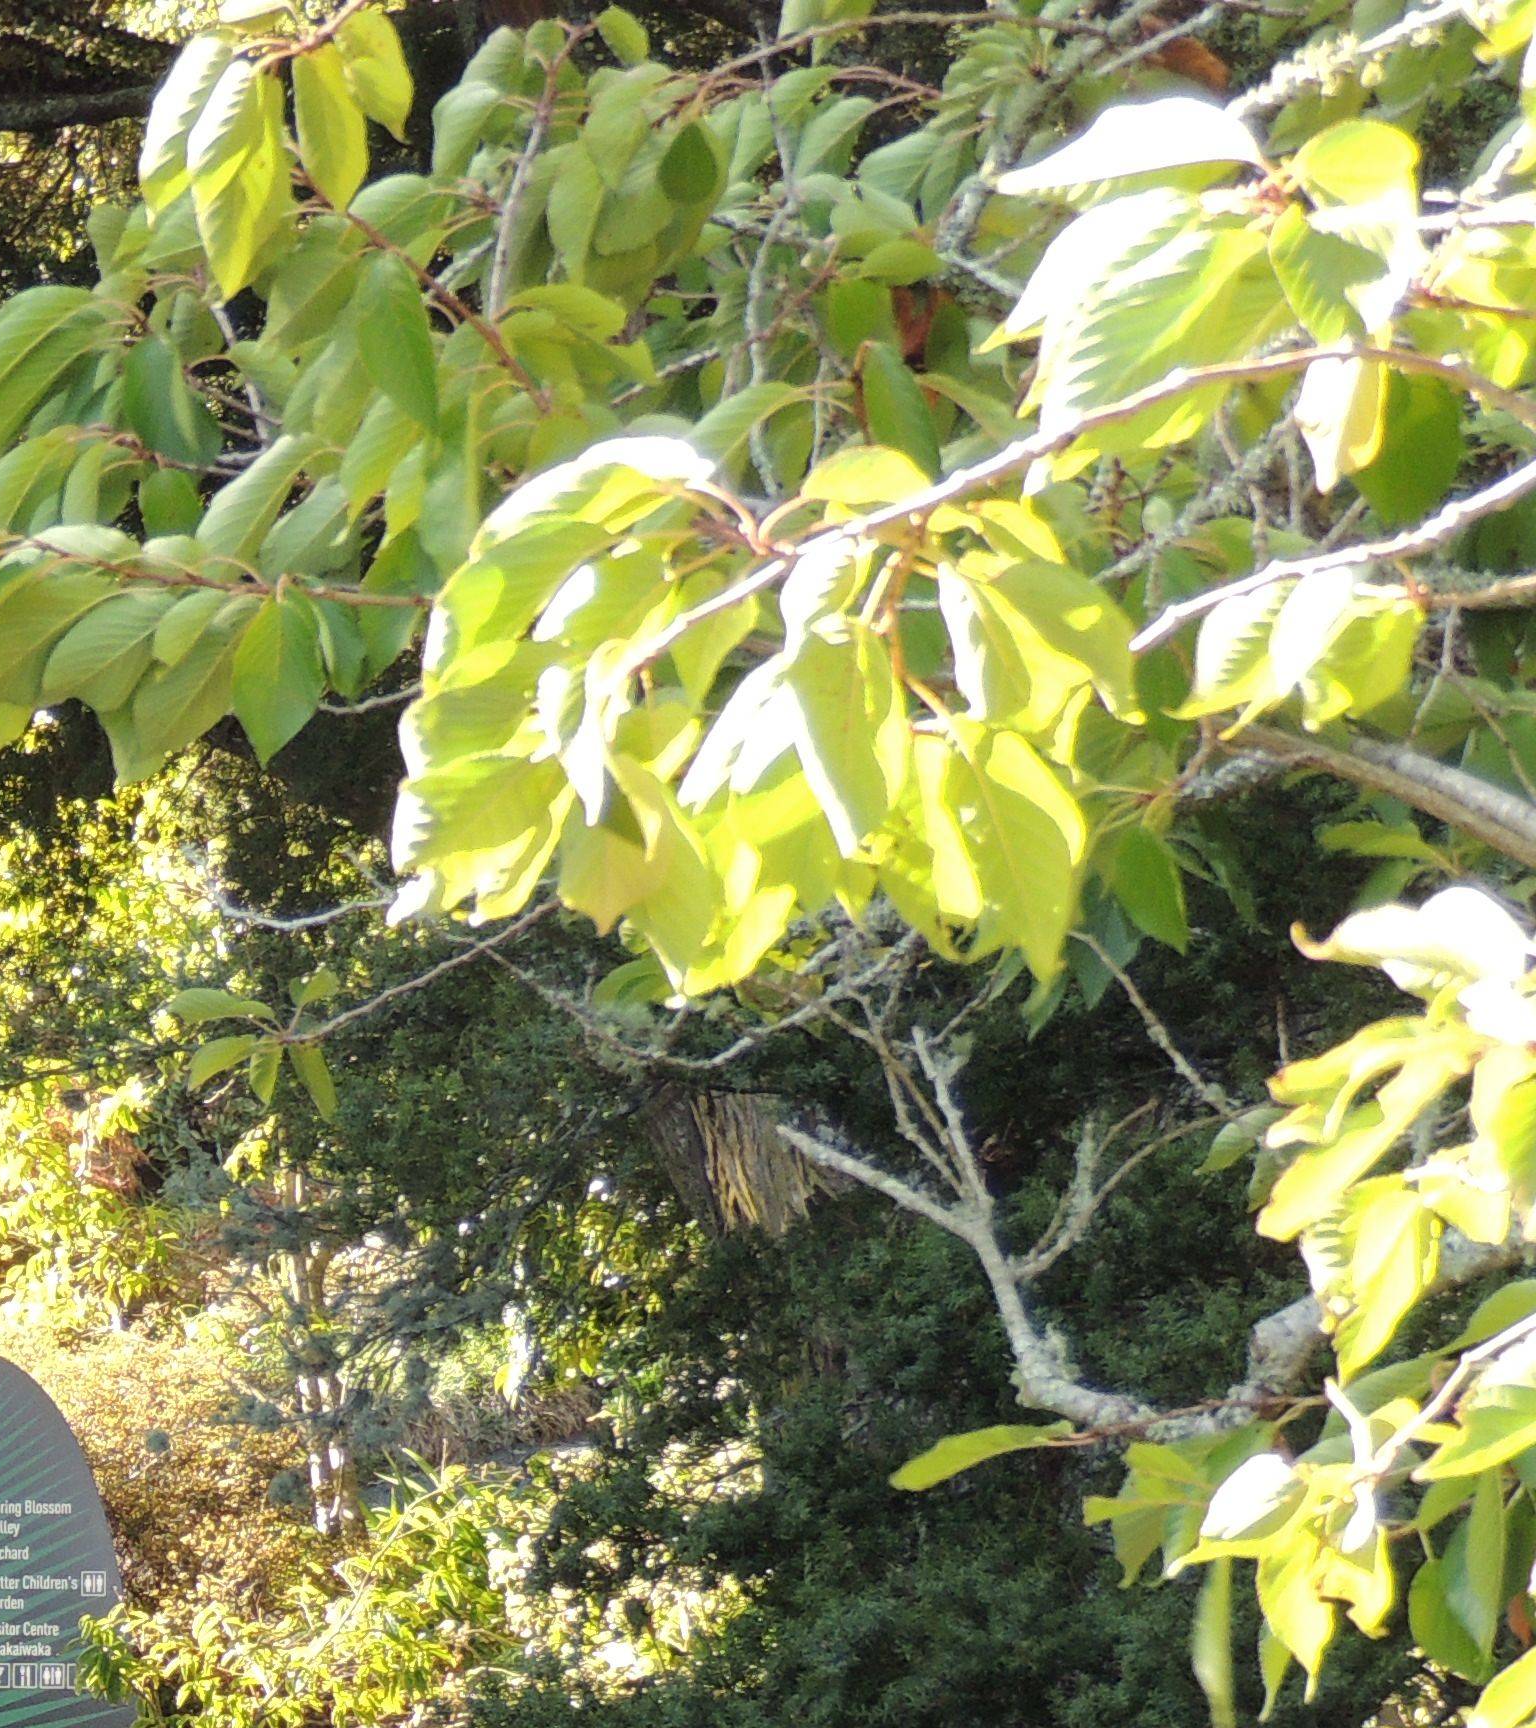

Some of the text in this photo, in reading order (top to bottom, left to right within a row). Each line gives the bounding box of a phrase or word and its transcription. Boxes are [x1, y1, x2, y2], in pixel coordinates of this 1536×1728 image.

[25, 1500, 71, 1514] Blossom
[23, 1575, 78, 1590] Children's
[23, 1622, 60, 1636] Centre
